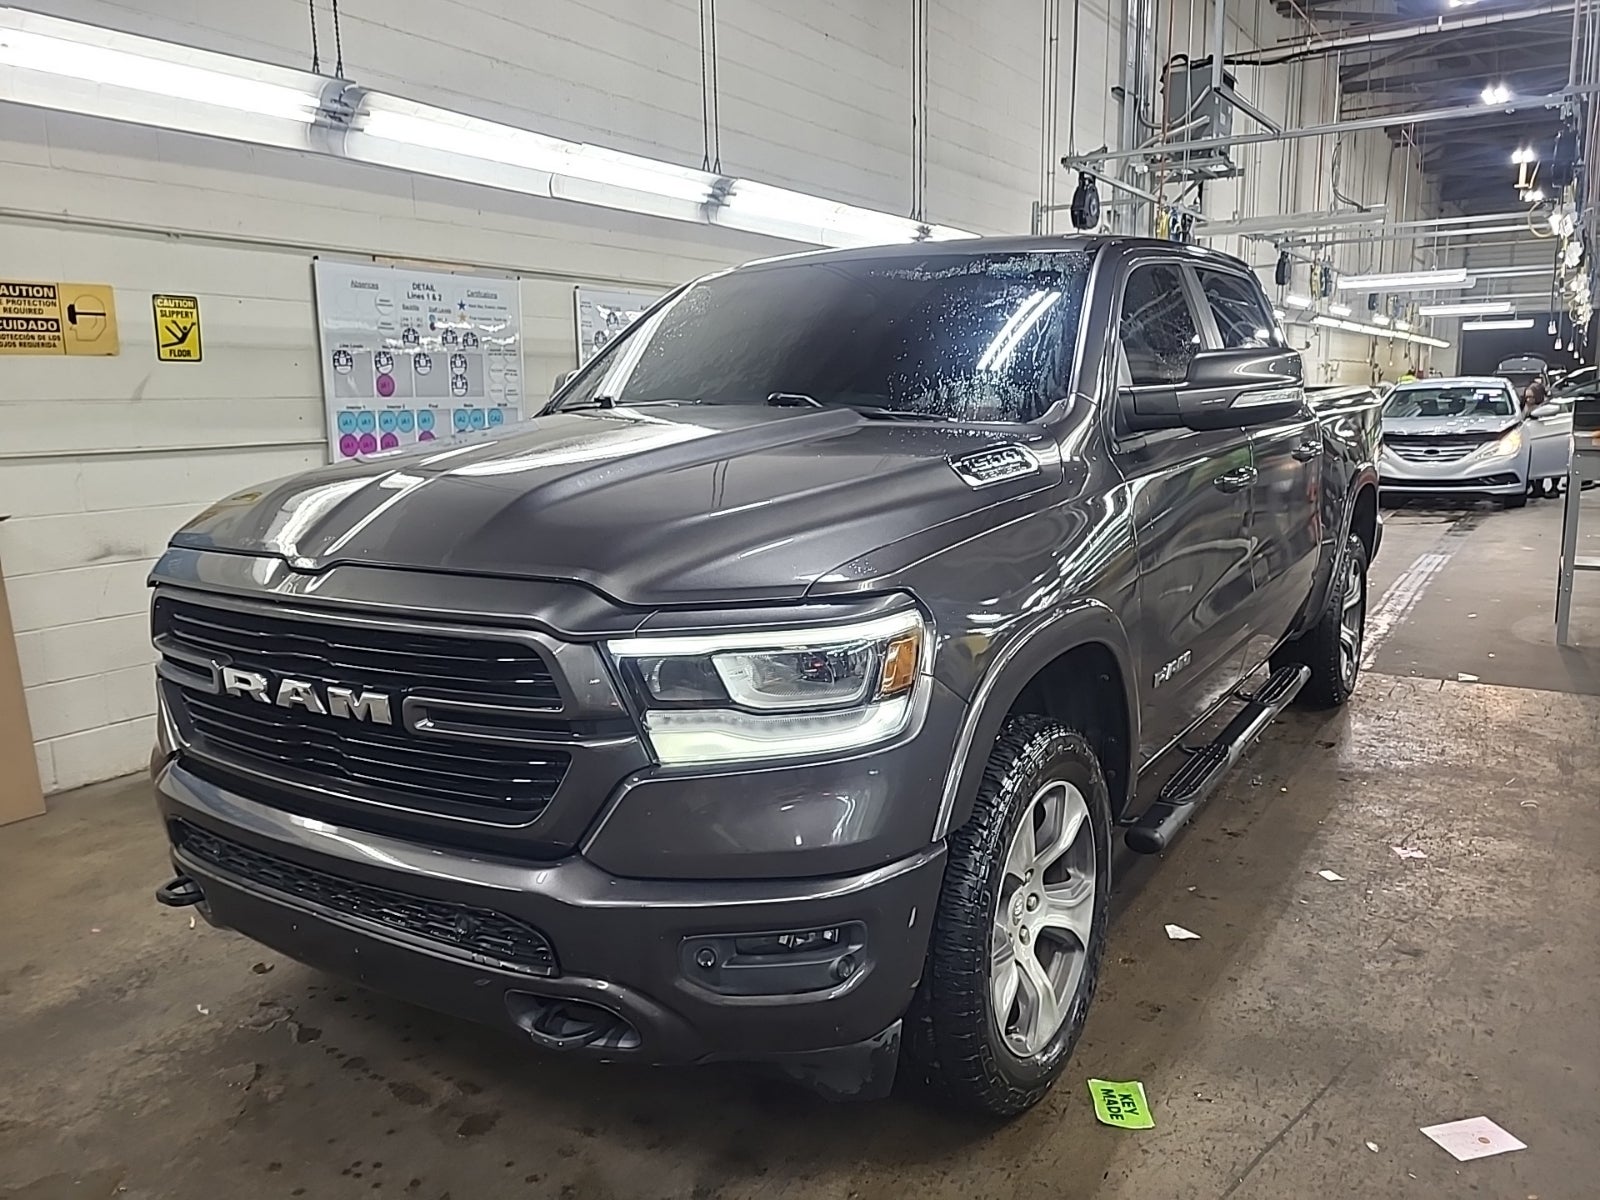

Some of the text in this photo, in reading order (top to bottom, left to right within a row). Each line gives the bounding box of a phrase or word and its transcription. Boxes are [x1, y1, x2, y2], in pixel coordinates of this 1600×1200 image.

[0, 285, 54, 298] AUTION
[412, 282, 436, 292] DETAIL
[407, 292, 425, 300] Lines
[6, 299, 57, 307] PROTECTION
[157, 298, 195, 308] CAUTION
[3, 307, 44, 315] REQUIRED
[160, 309, 194, 319] SLIPPERY
[0, 333, 35, 341] OTECCIÓN
[169, 349, 192, 358] FLOOR
[223, 667, 393, 725] RAM
[1101, 1088, 1125, 1120] MADE
[1118, 1093, 1139, 1115] KEY
